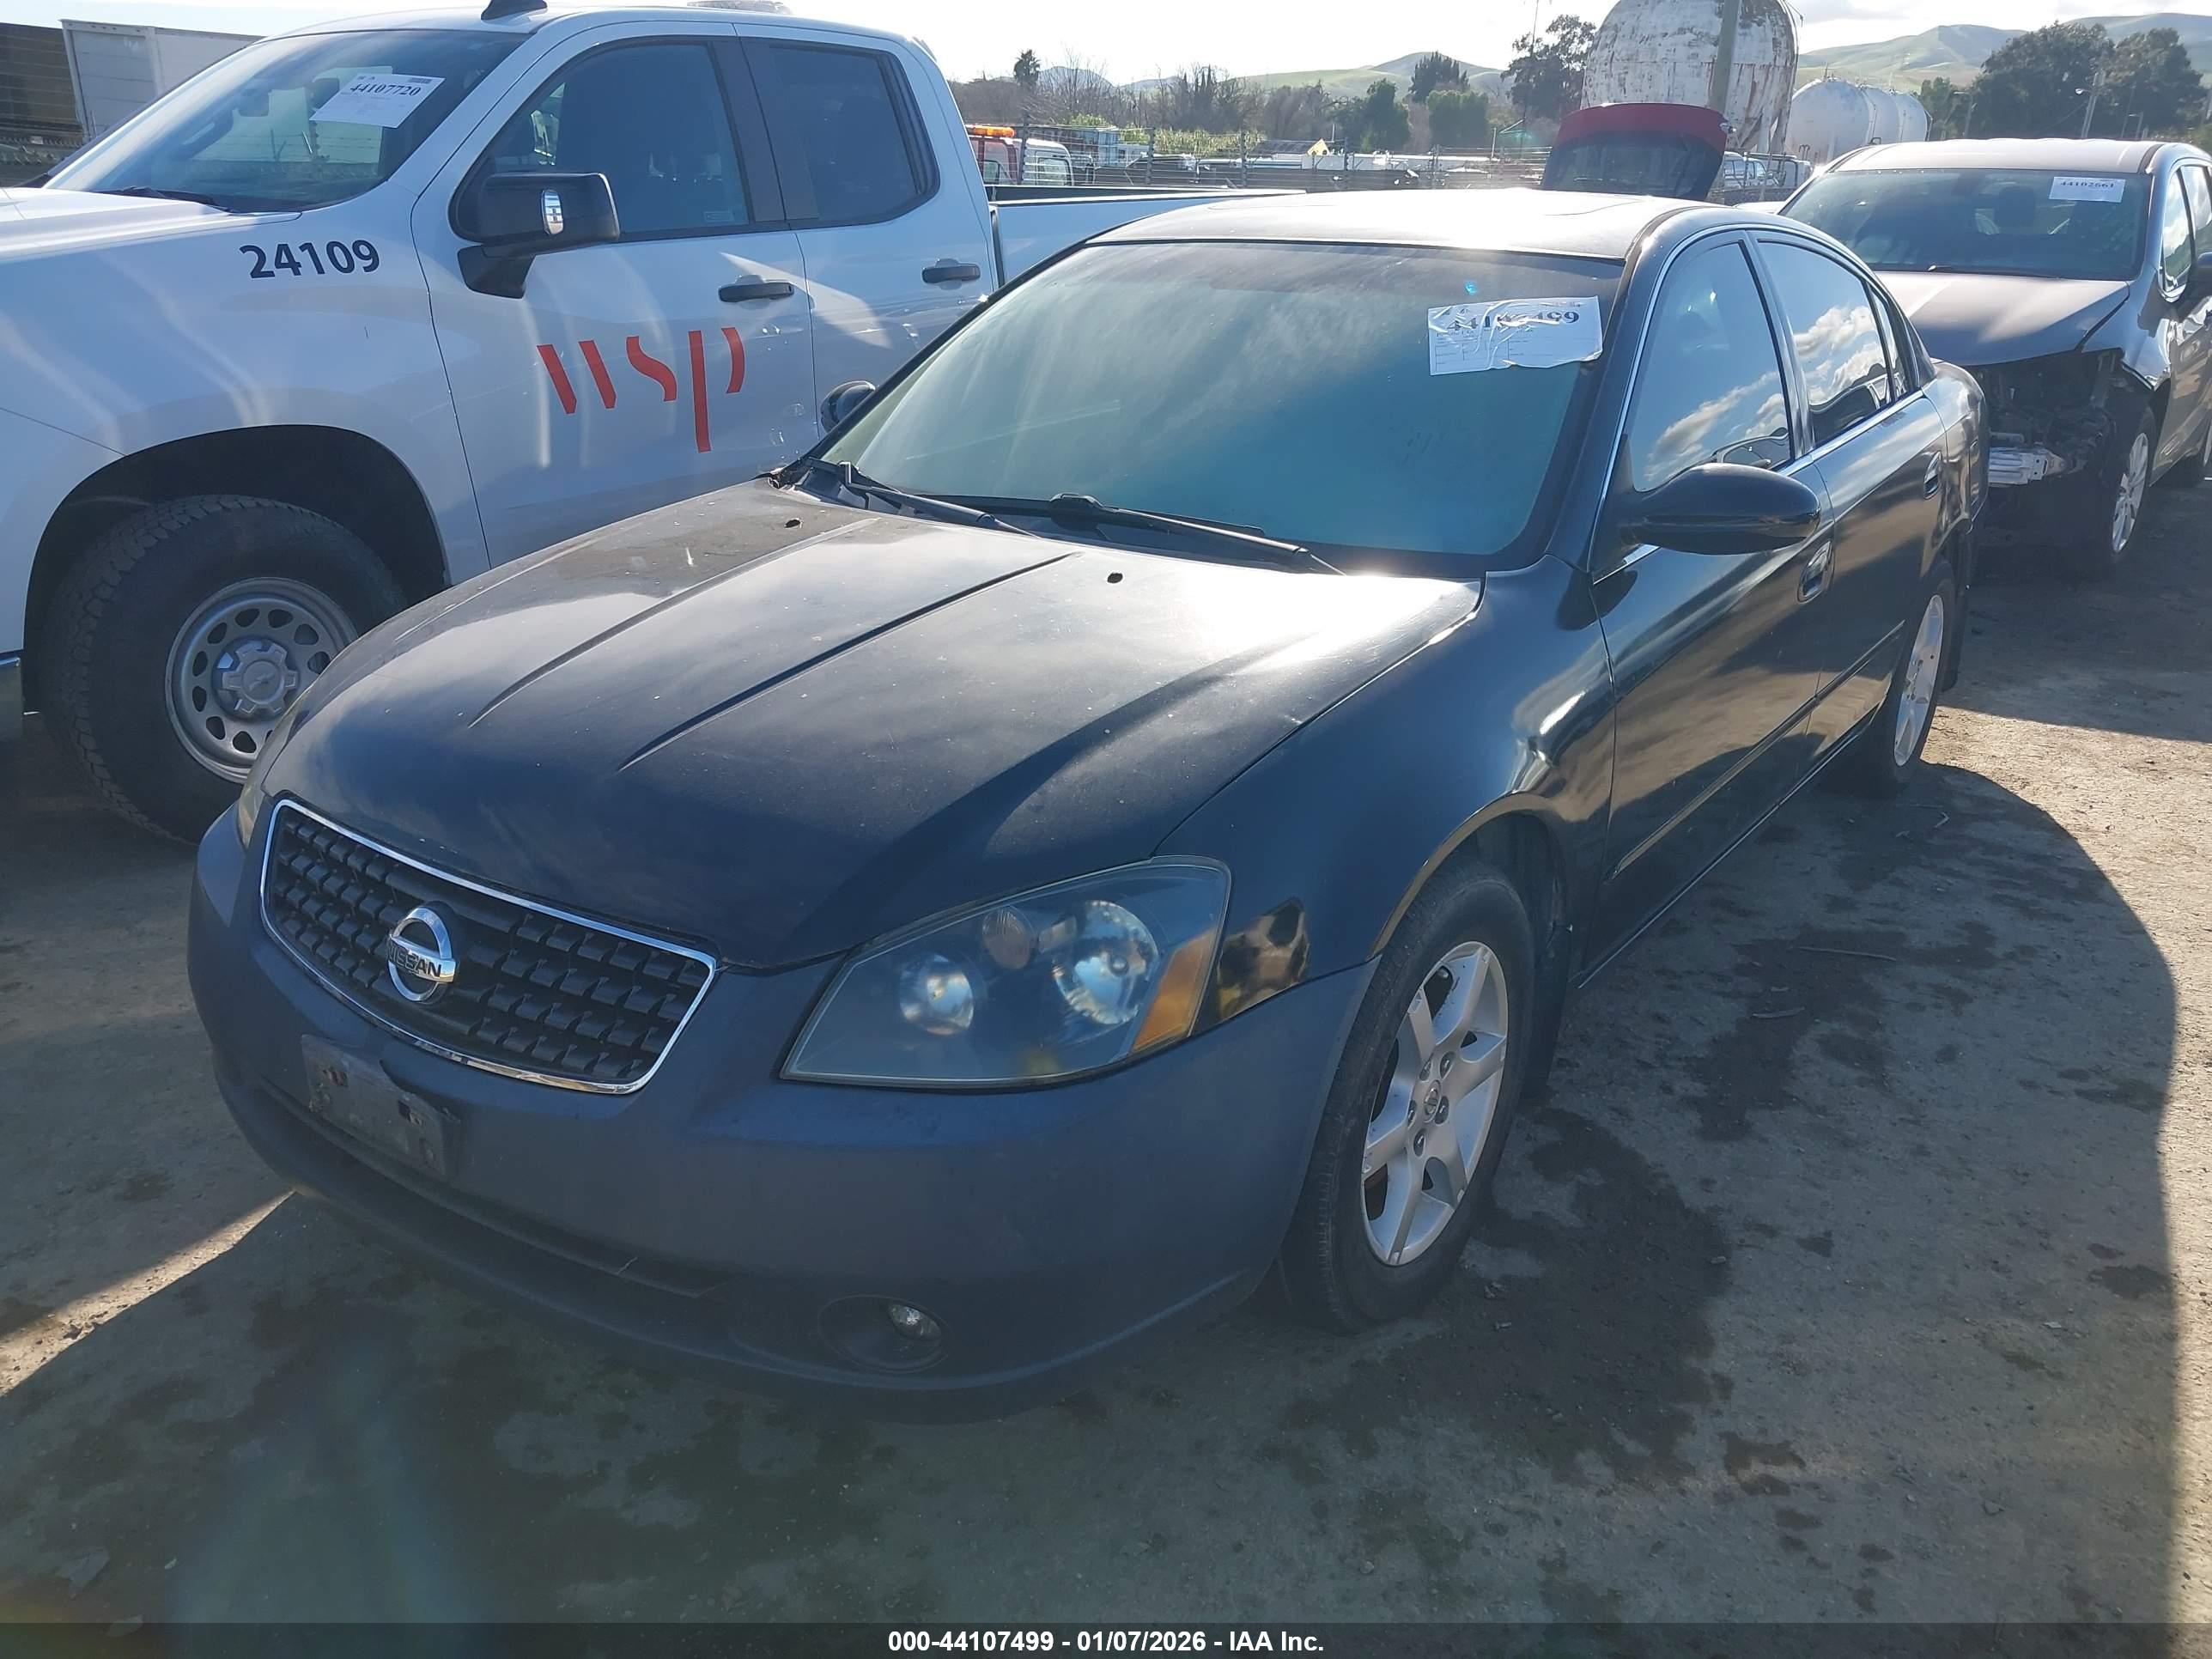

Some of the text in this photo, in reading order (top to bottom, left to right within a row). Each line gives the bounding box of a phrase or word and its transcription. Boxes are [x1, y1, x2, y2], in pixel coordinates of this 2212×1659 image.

[350, 82, 422, 97] 44107720
[239, 239, 380, 279] 24109
[387, 941, 442, 978] NISSAN
